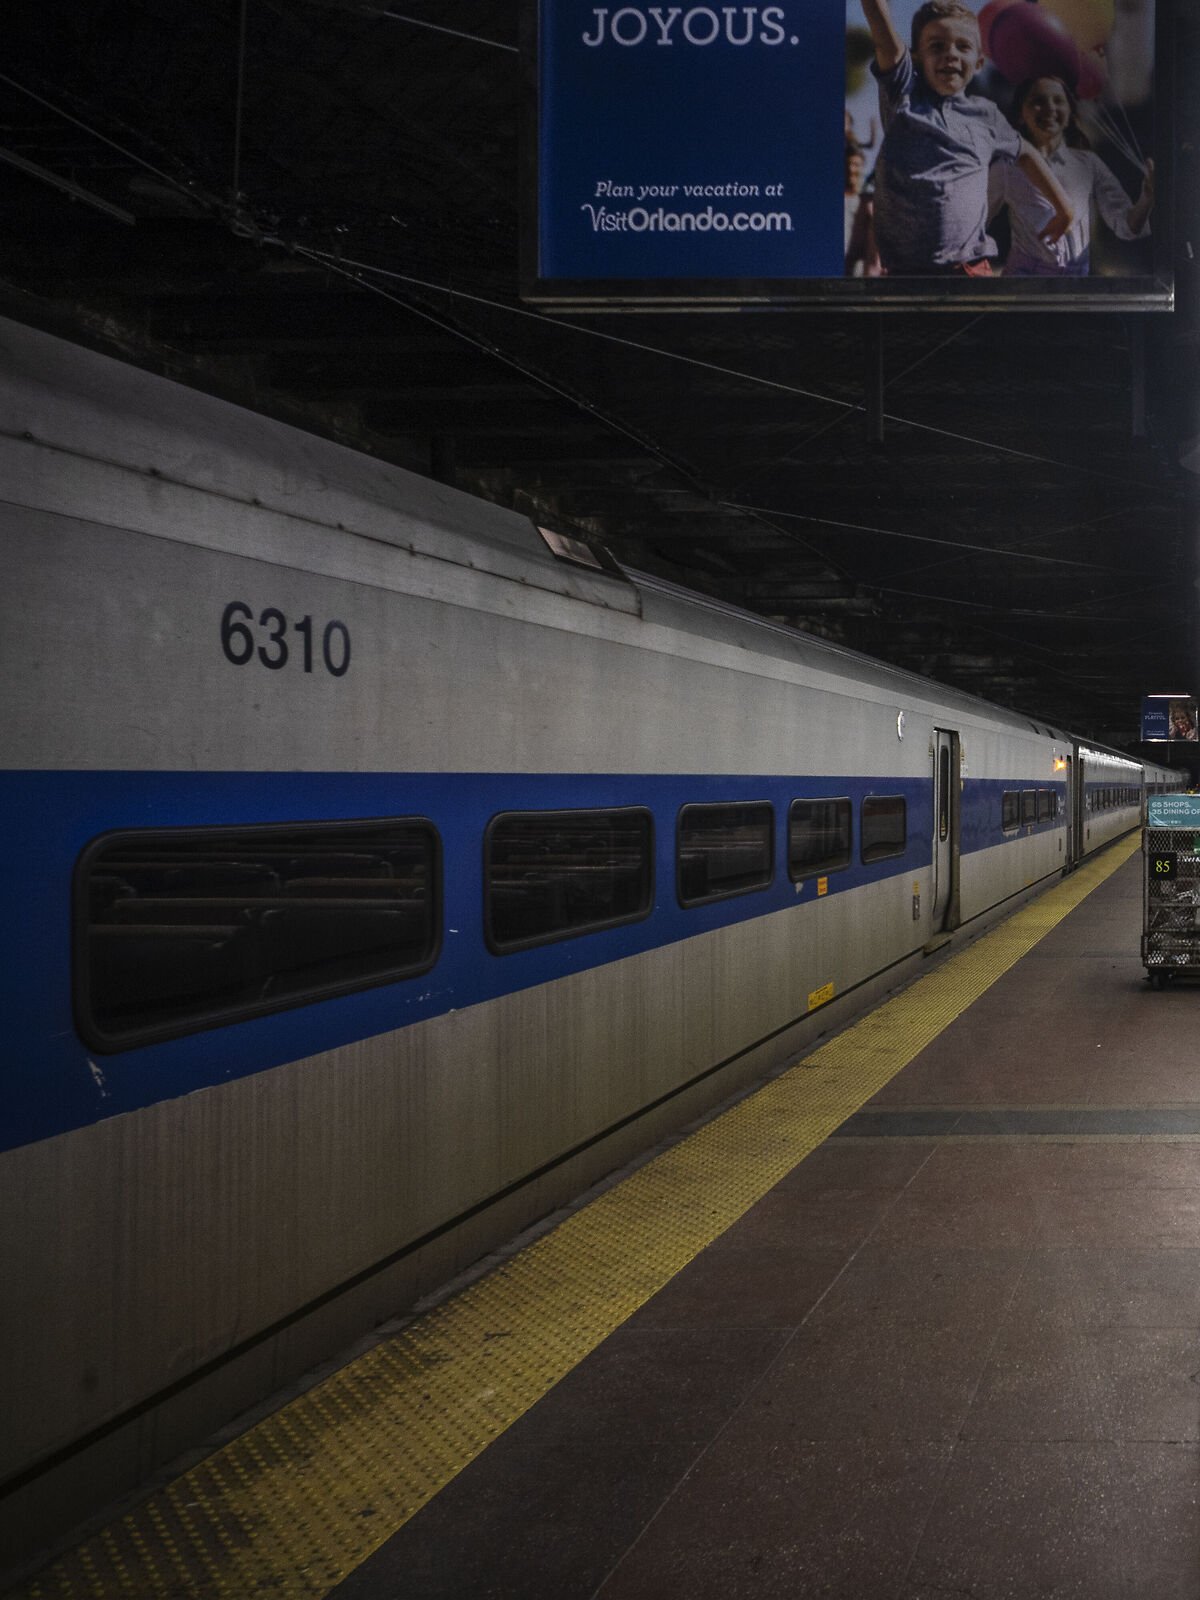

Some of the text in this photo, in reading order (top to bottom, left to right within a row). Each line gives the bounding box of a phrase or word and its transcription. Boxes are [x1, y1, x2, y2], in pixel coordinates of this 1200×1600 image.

[582, 6, 799, 47] JOYOUS.
[594, 180, 784, 201] Plan your vacation at
[580, 203, 793, 232] VisitOrlando.com
[220, 600, 351, 677] 6310
[1155, 860, 1170, 873] 85
